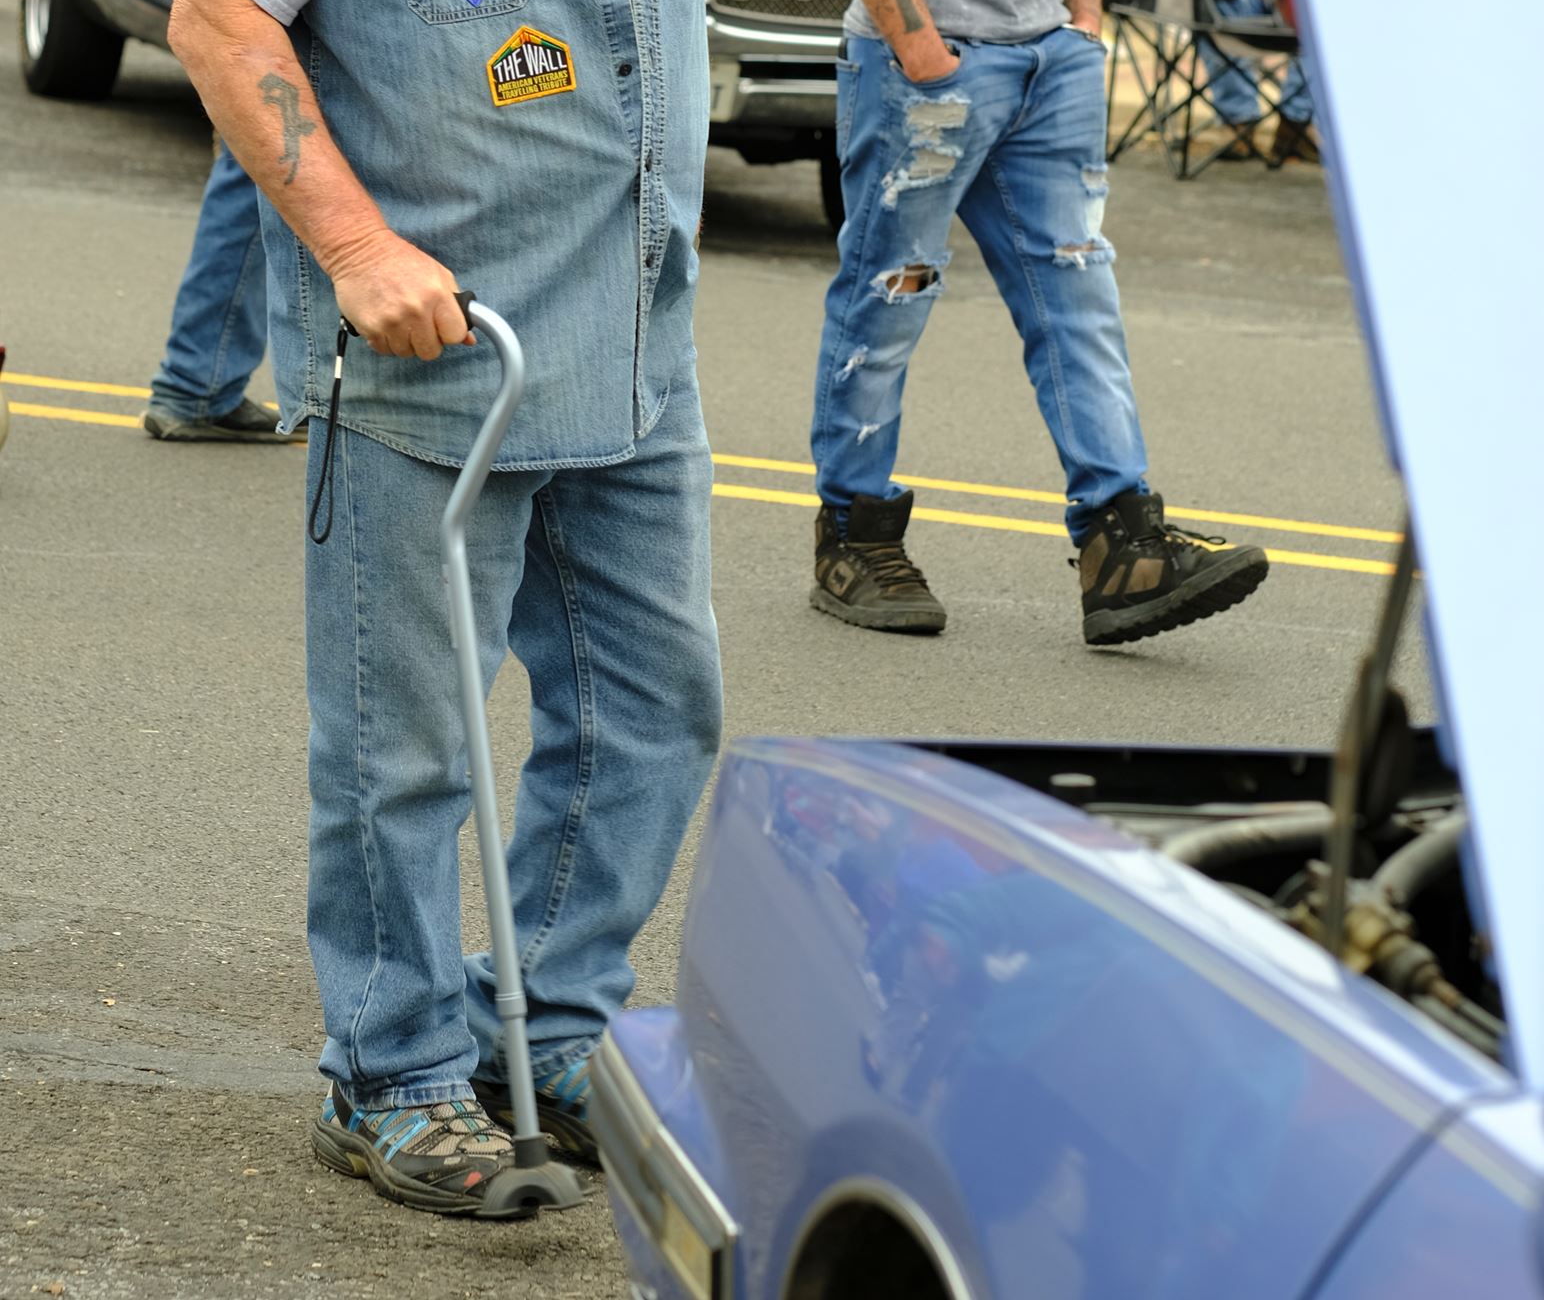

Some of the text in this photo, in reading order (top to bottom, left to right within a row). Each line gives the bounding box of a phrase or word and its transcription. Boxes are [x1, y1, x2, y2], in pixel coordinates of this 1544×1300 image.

[493, 43, 567, 83] THE WALL
[498, 70, 568, 93] AMERICAN VETERANS
[501, 79, 568, 100] TRAVELING TRIBUTE
